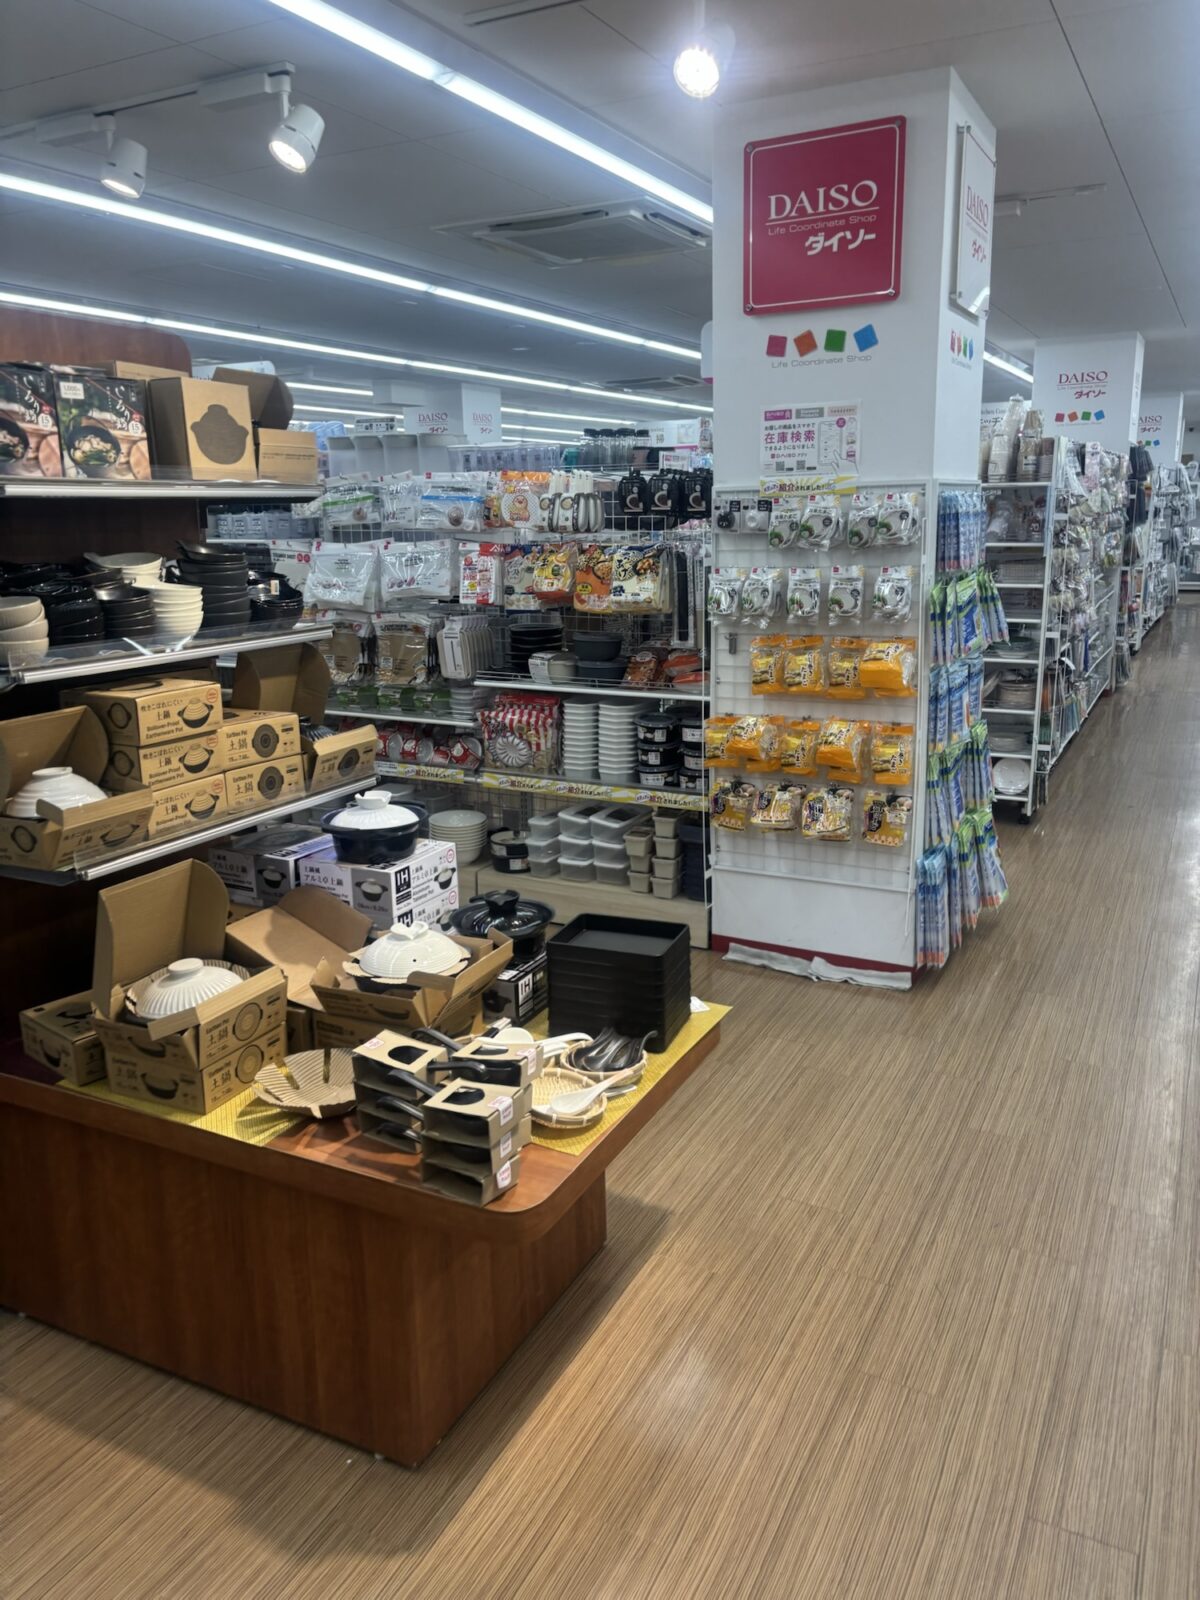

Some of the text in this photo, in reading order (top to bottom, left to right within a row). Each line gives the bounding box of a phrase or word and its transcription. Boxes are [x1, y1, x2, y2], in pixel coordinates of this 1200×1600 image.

[767, 180, 878, 220] DAISO
[966, 185, 989, 227] DAISO
[768, 214, 877, 236] Life Coordinate Shop
[804, 228, 877, 256] ダイソー
[771, 354, 873, 369] Life Coordinate Shop
[1058, 370, 1109, 384] DAISO
[1074, 390, 1107, 399] ダイソー
[418, 412, 448, 422] DAISO
[472, 412, 493, 421] DAISO
[1139, 415, 1162, 424] AISO
[764, 430, 816, 444] 在庫検索
[157, 710, 171, 721] 土鍋
[227, 738, 248, 751] 土鍋
[159, 757, 172, 768] 土鍋
[320, 762, 335, 774] 土鍋
[234, 781, 254, 796] 土鍋
[165, 804, 179, 815] 土鍋
[396, 868, 409, 887] IH
[520, 977, 531, 996] IH
[207, 1026, 229, 1047] 土鍋
[210, 1069, 232, 1090] 土鍋
